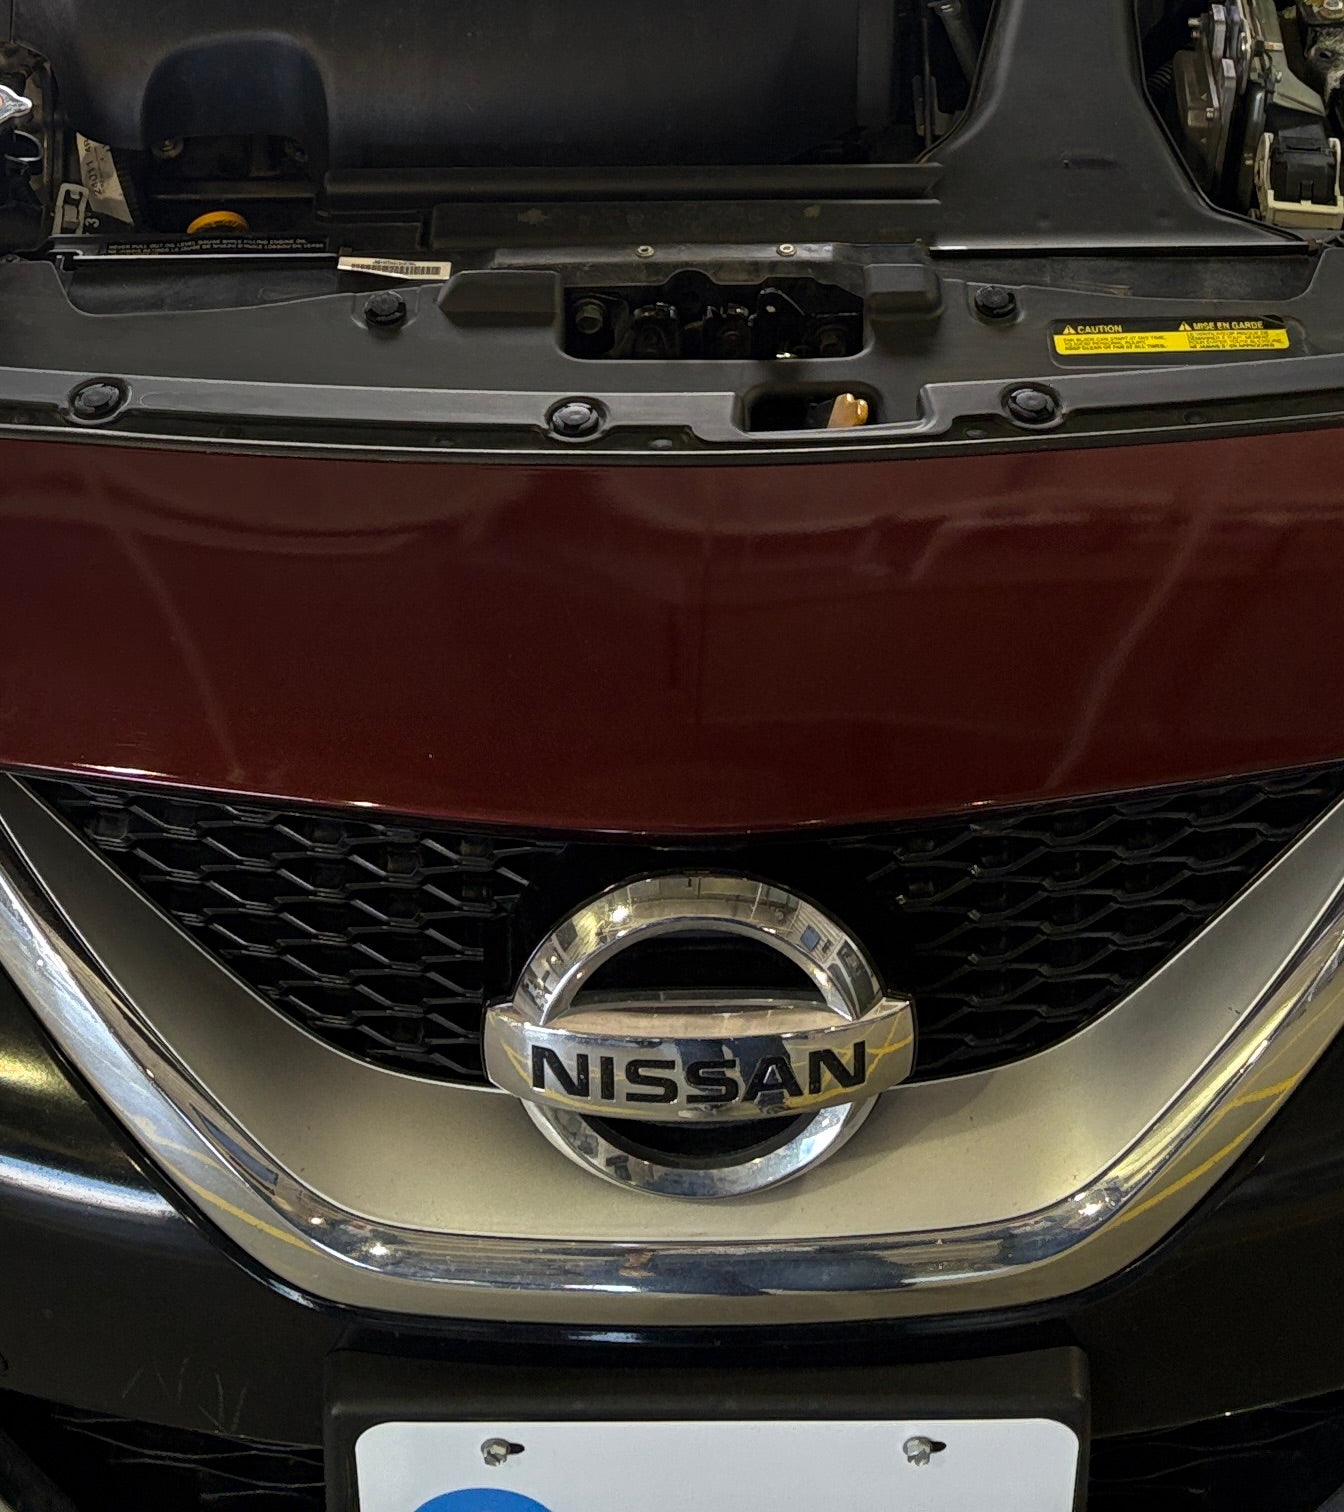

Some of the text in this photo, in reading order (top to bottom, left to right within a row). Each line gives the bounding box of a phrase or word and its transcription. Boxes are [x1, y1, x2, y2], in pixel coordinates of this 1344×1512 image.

[1077, 324, 1123, 334] CAUTION
[1193, 320, 1264, 330] MISE EN GARDE
[531, 1039, 866, 1104] NISSAN
